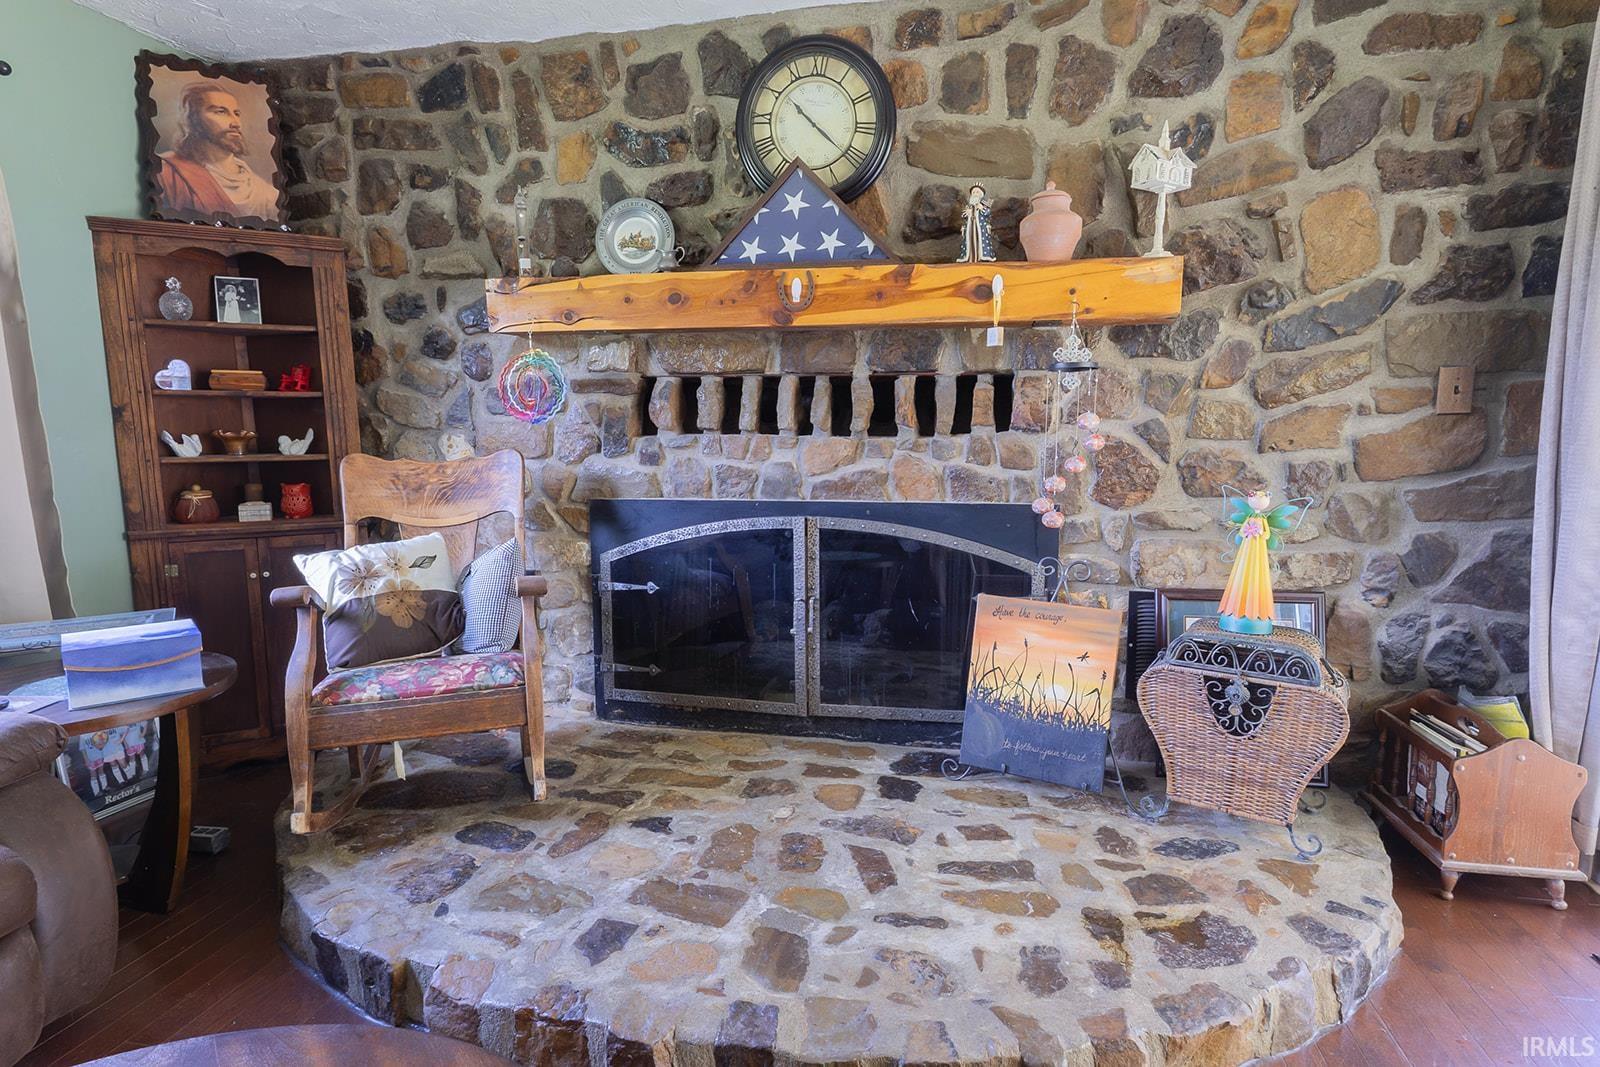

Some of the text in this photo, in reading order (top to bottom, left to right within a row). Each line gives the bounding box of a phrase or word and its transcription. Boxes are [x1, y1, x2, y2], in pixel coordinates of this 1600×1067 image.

[617, 201, 650, 212] AMERICAN
[650, 206, 672, 239] REVOLUTION
[991, 605, 1015, 621] Have
[1018, 607, 1031, 619] the
[1060, 751, 1088, 763] heart
[104, 784, 141, 805] Rector's
